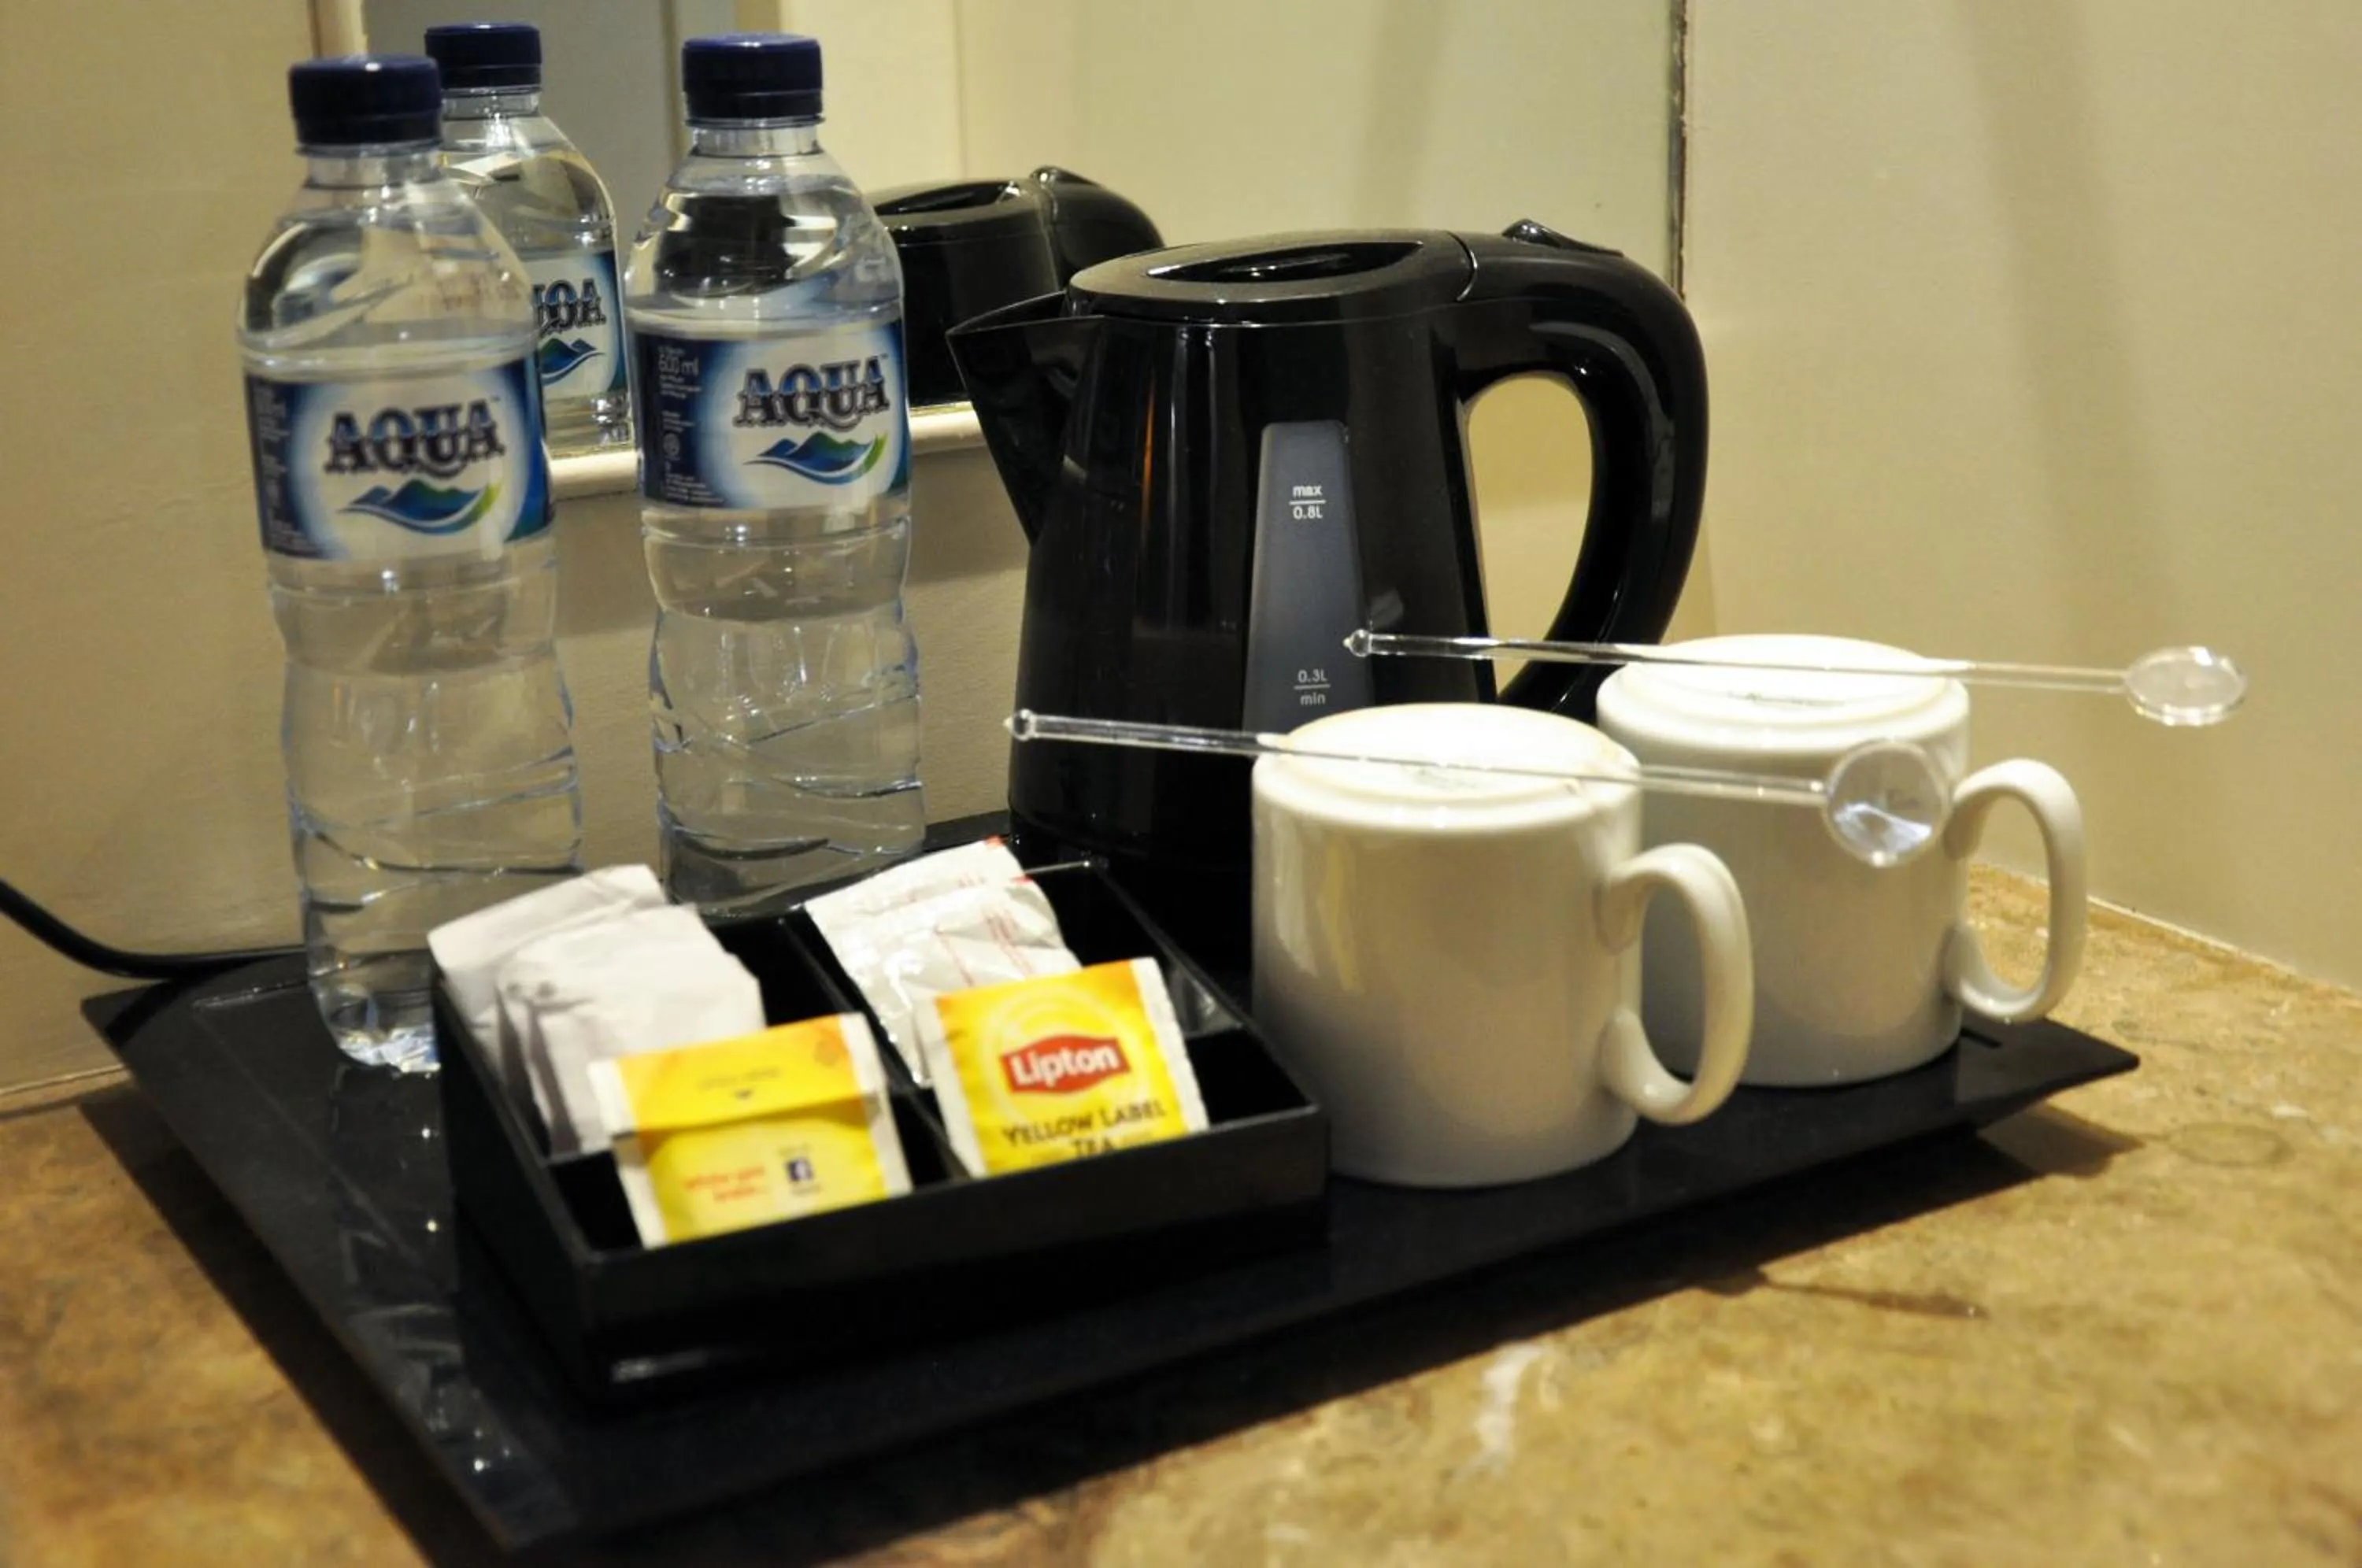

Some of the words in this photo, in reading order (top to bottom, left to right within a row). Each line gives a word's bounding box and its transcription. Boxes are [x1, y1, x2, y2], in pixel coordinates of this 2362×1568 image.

[732, 354, 890, 432] AQUA
[324, 398, 505, 479] AQUA
[1292, 485, 1323, 497] max
[1292, 505, 1324, 520] 0.8L
[1298, 668, 1327, 682] 0.3L
[1299, 691, 1326, 705] min
[1008, 1045, 1121, 1088] Lipton
[1001, 1112, 1094, 1147] YELLOW
[1098, 1099, 1166, 1128] LABEL
[1072, 1137, 1116, 1157] TEA
